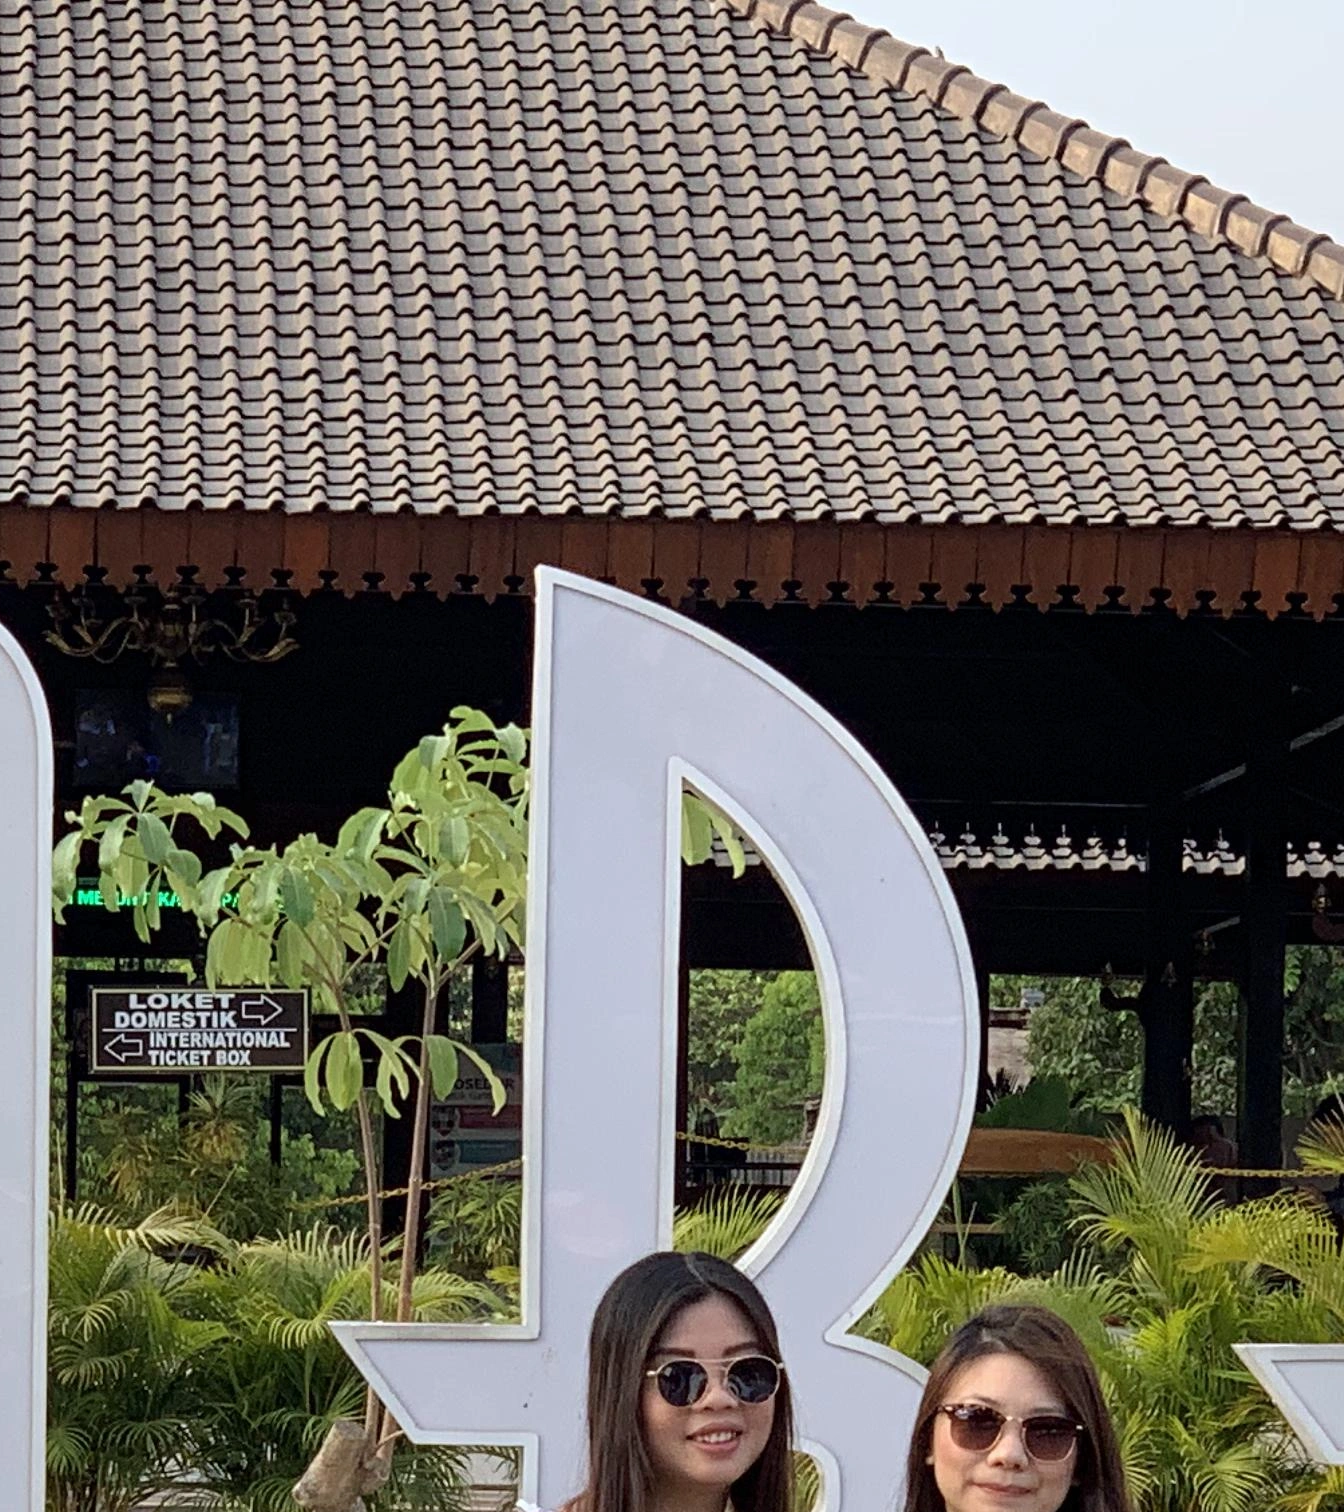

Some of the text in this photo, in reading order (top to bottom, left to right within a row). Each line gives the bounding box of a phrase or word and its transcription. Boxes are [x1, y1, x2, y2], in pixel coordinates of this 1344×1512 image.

[128, 993, 236, 1010] LOKET
[114, 1011, 238, 1029] DOMESTIK
[150, 1031, 291, 1048] INTERNATIONAL
[148, 1050, 251, 1066] TICKET BOX
